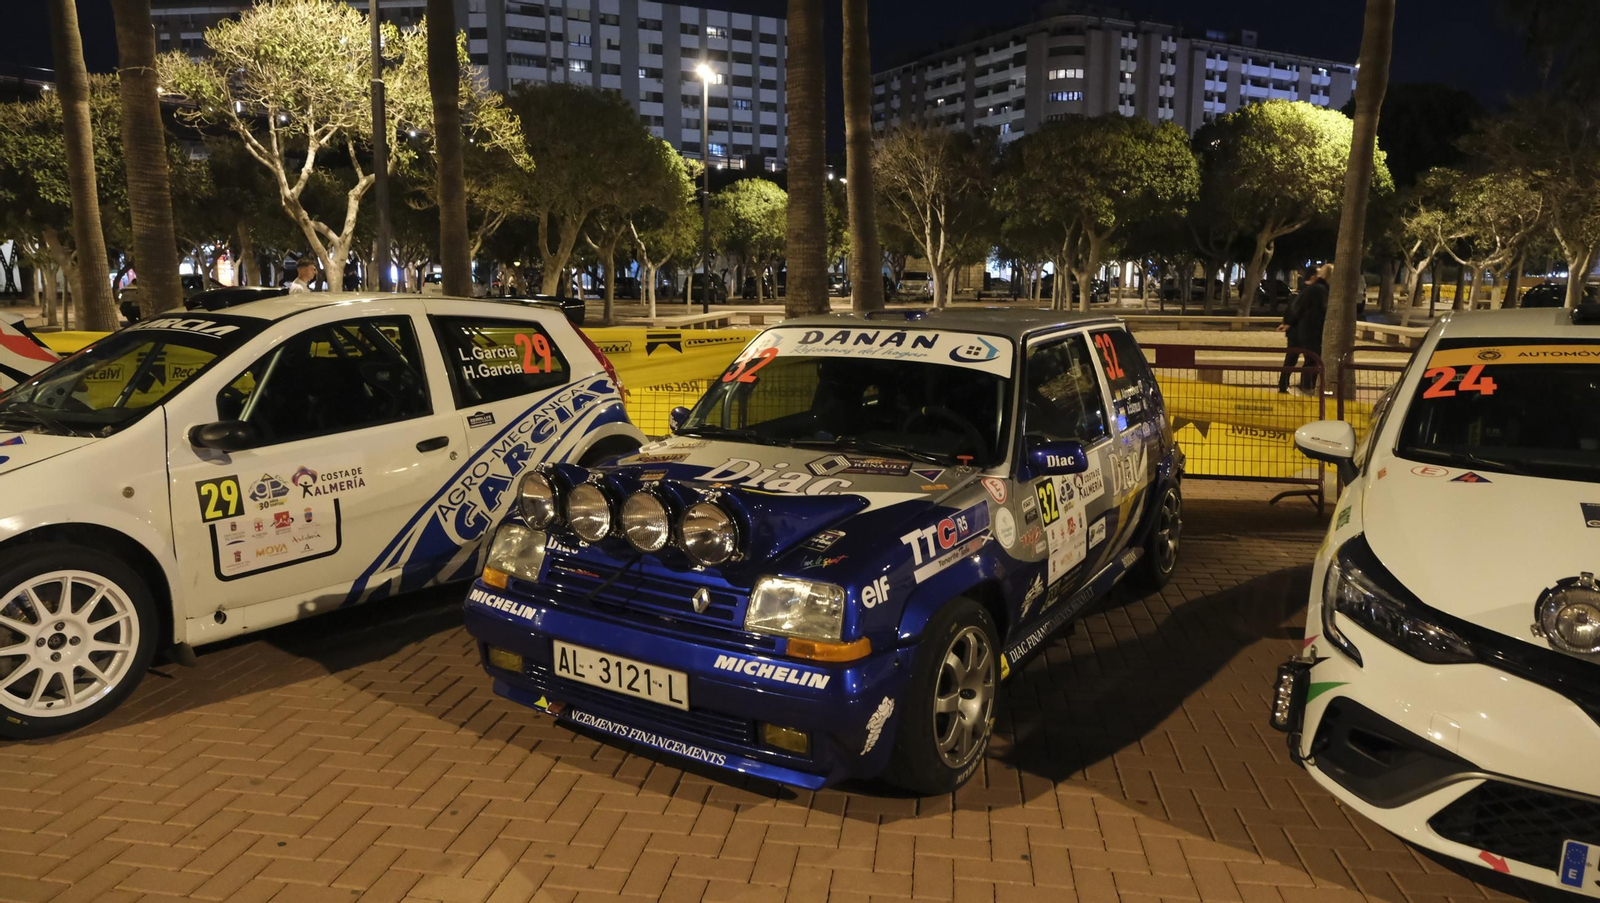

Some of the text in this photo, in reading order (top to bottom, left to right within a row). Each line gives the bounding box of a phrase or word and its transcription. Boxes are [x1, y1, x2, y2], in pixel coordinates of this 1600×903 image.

[514, 333, 551, 374] 29
[722, 347, 779, 382] 32
[858, 347, 880, 355] del
[1095, 333, 1125, 380] 32
[86, 368, 121, 380] ecalvi
[1423, 365, 1497, 399] 24
[321, 467, 363, 482] COSTA DE
[694, 457, 853, 495] Diac
[1047, 454, 1075, 468] Diac
[1108, 448, 1146, 496] Diac
[1421, 467, 1438, 476] E
[201, 479, 238, 519] 29
[315, 476, 366, 497] ALMERÍA
[990, 481, 1001, 492] E
[259, 501, 269, 510] 30
[1038, 482, 1059, 524] 32
[957, 515, 968, 532] R5
[256, 543, 288, 557] MOYA
[900, 518, 956, 566] TTC
[469, 588, 537, 620] MICHELIN
[861, 575, 890, 609] elf
[1009, 641, 1028, 663] DIAC
[713, 654, 831, 690] MICHELIN
[627, 727, 727, 767] FINANCEMENTS
[1568, 868, 1578, 880] E
